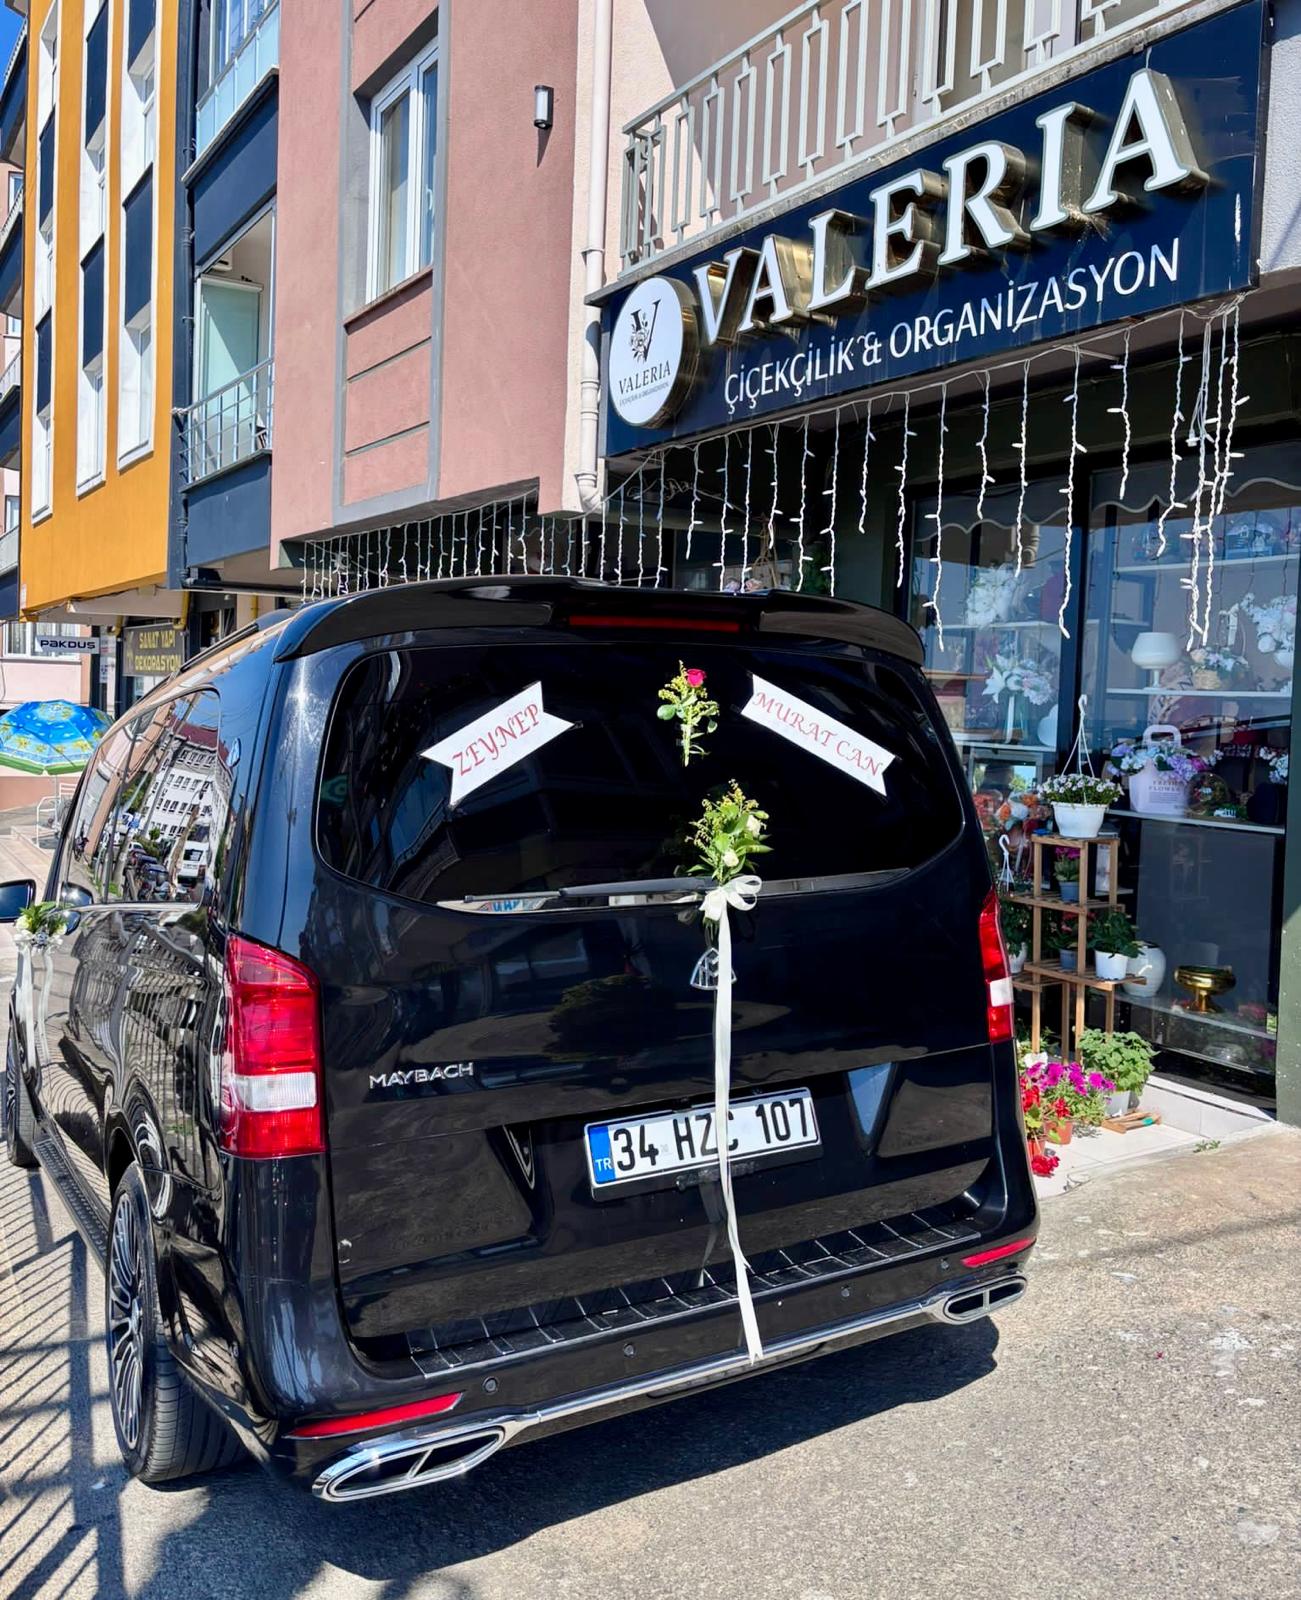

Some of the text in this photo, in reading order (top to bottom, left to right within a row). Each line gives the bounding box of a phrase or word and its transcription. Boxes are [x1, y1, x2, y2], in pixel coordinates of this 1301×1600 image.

[692, 67, 1190, 346] VALERIA
[724, 237, 1179, 415] ÇİÇEKÇİLİK & ORGANİZASYON
[618, 360, 671, 395] VALERIA
[452, 703, 540, 777] ZEYNEP
[752, 691, 883, 776] MURAT CAN
[369, 1062, 474, 1090] MAYBACH
[594, 1157, 613, 1172] TR
[613, 1124, 660, 1171] 34
[755, 1097, 808, 1145] 107
